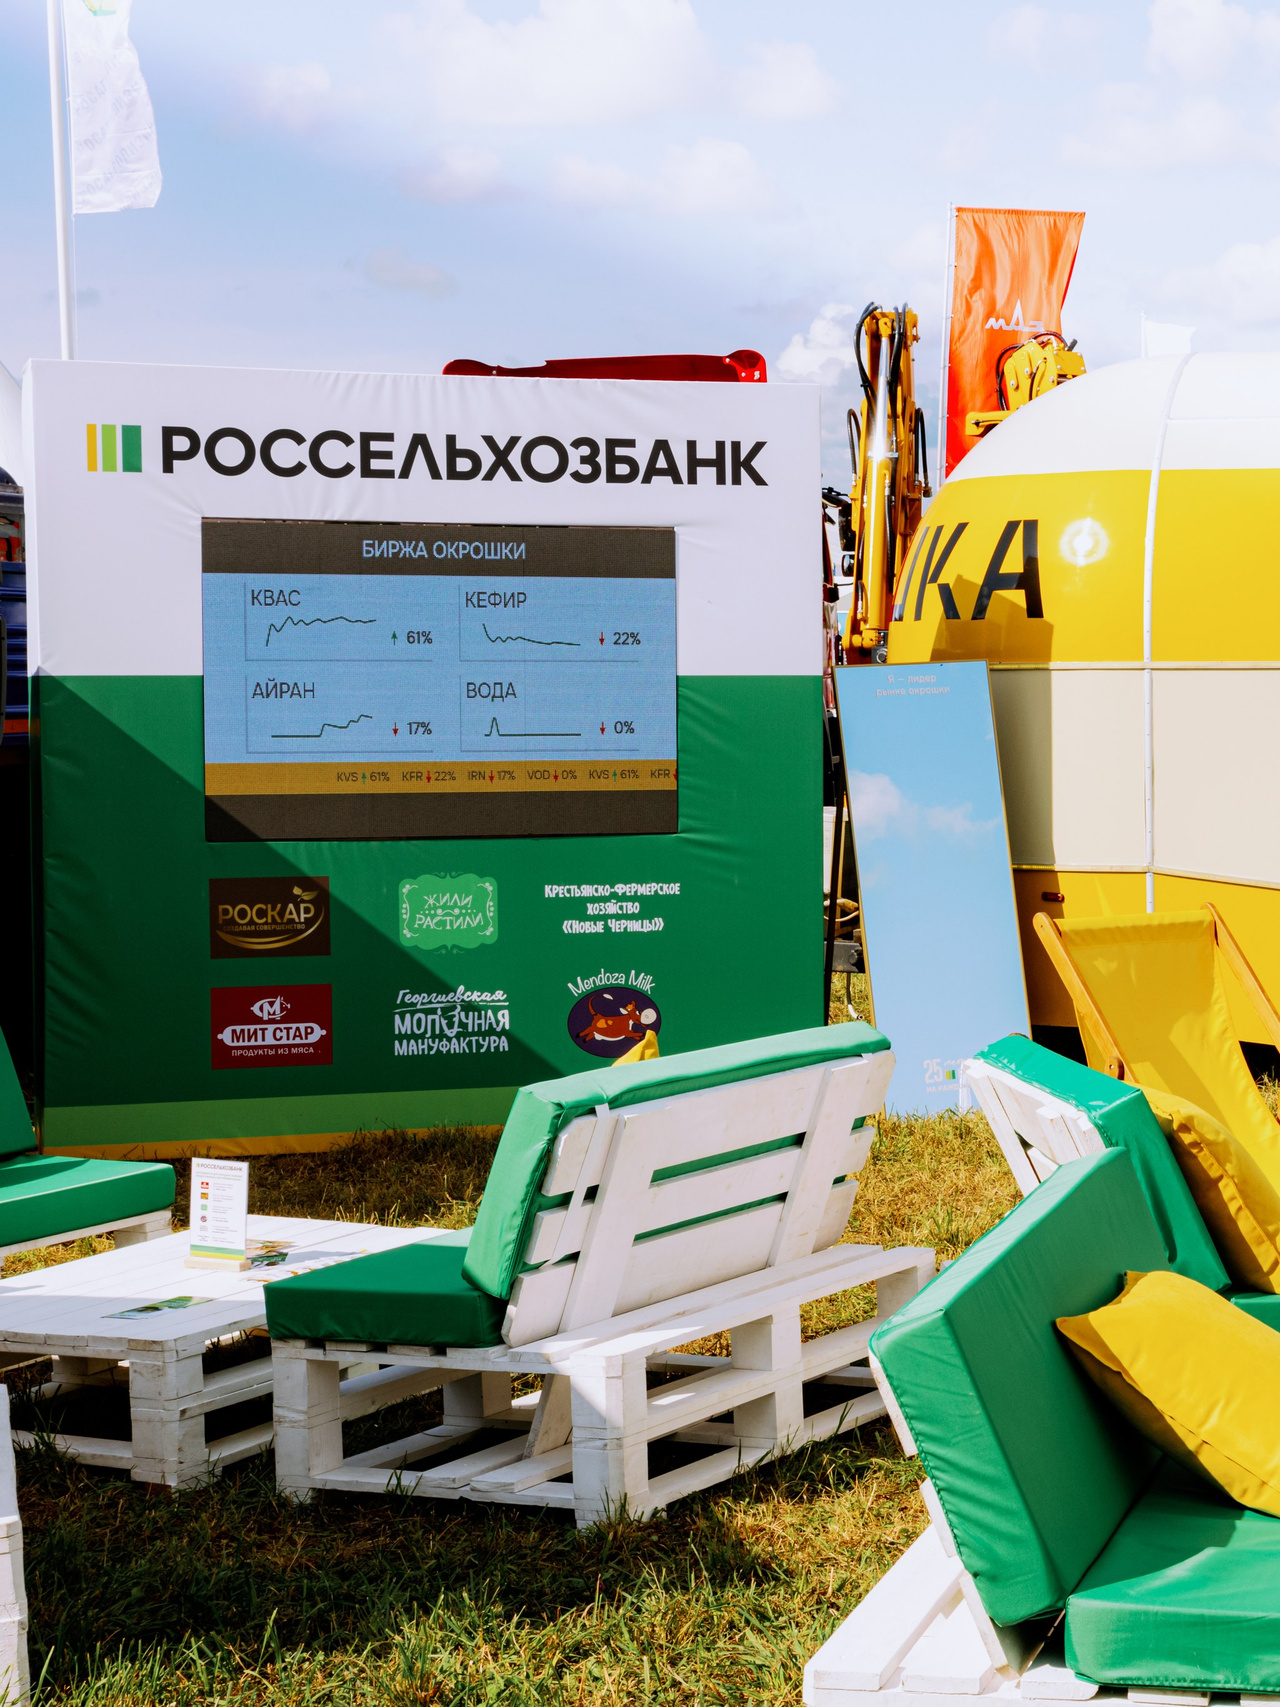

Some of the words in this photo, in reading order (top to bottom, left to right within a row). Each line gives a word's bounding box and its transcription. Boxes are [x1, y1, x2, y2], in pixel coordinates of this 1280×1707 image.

[161, 424, 769, 487] РОССЕЛЬХОЗБАНК
[362, 540, 428, 559] БИРЖА
[433, 541, 527, 561] ОКРОШКИ
[251, 589, 301, 607] КВАС
[465, 591, 528, 609] КЕФИР
[406, 631, 433, 645] 61%
[613, 632, 641, 646] 22%
[252, 678, 316, 699] АЙРАН
[466, 682, 517, 702] ВОДА
[407, 721, 432, 736] 17%
[614, 720, 635, 735] 0%
[337, 772, 358, 782] KVS
[369, 771, 390, 782] 61%
[402, 771, 423, 782] KFR
[434, 771, 456, 782] 22%
[468, 771, 486, 781] IRN
[497, 770, 516, 781] 17%
[527, 770, 551, 781] VOD
[561, 770, 577, 780] 0%
[589, 769, 610, 780] KVS
[620, 769, 640, 780] 61%
[650, 769, 671, 779] KFR
[423, 893, 473, 909] ЖИЛИ
[586, 900, 640, 915] ХОЗЯЙСТВО
[218, 903, 315, 924] РОСКАР
[414, 912, 484, 930] РАСТИЛИ
[567, 968, 626, 997] Mendoza
[629, 970, 655, 994] Milk
[396, 985, 507, 1009] Георгиевская
[231, 1027, 268, 1043] МИТ
[272, 1026, 315, 1042] СТАР
[232, 1048, 275, 1057] ПРОДУКТЫ
[394, 1035, 509, 1056] МАНУФАКТУРА
[200, 1163, 243, 1171] РОССЕЛЬХОЗБАНК
